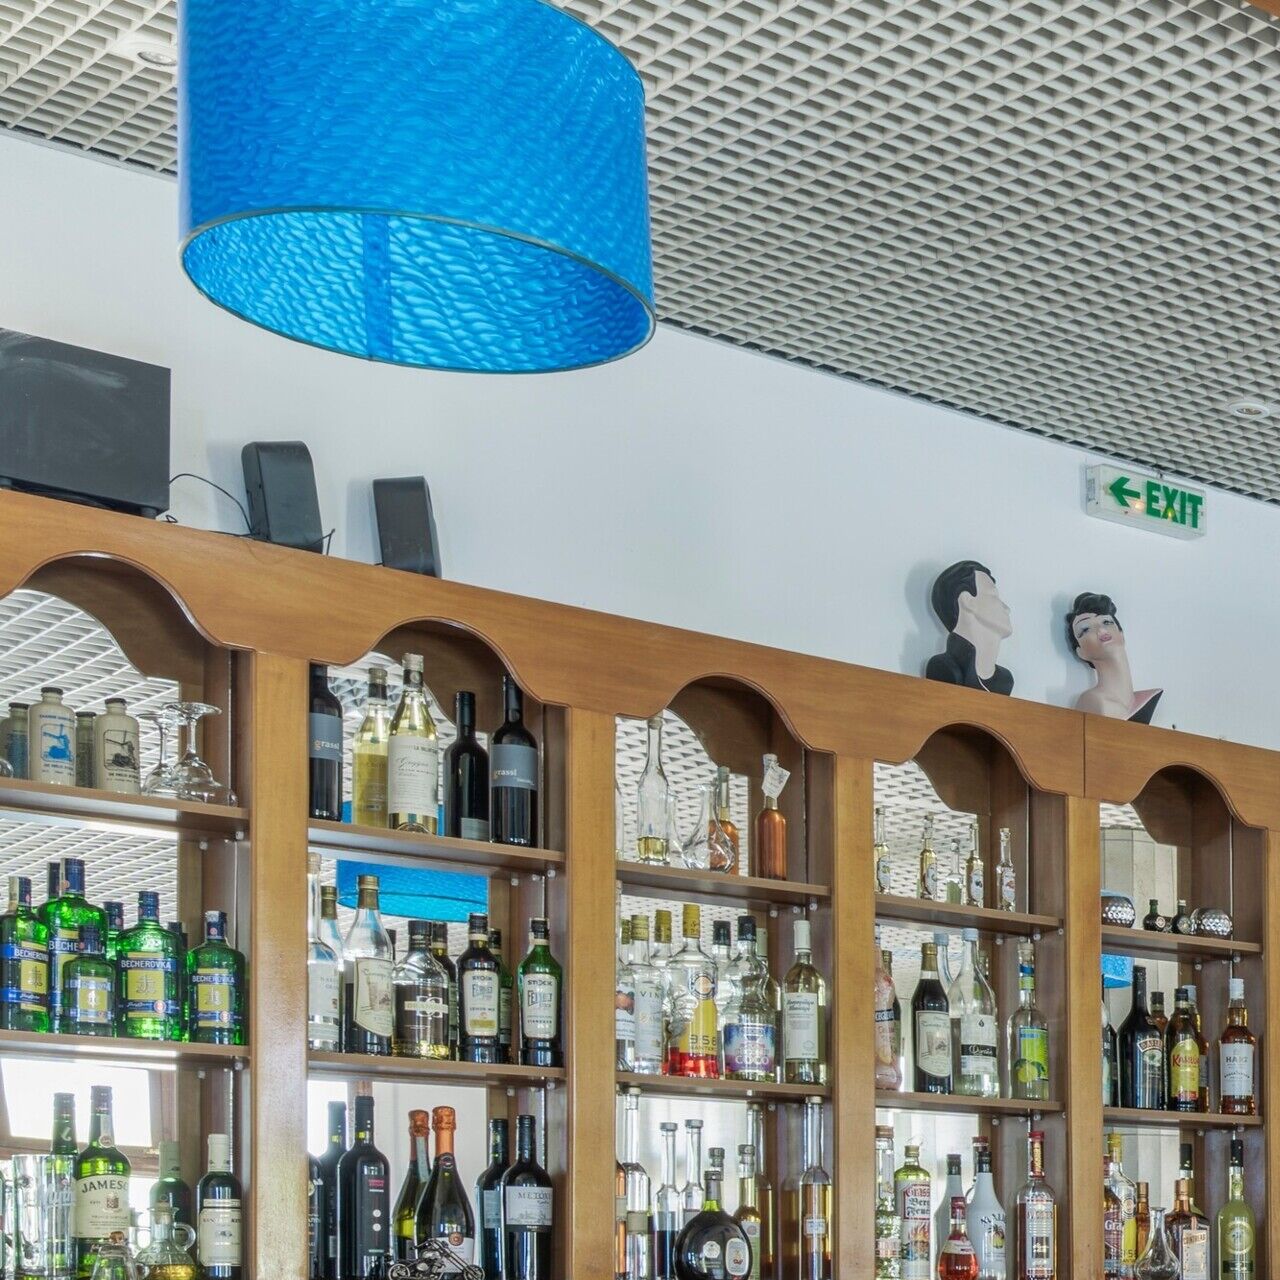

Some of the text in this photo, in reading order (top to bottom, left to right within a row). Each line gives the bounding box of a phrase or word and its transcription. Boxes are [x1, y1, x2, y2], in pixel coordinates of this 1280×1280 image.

[1146, 480, 1203, 529] EXIT
[120, 960, 172, 970] BECHEROVKA
[1104, 1219, 1123, 1232] Gra
